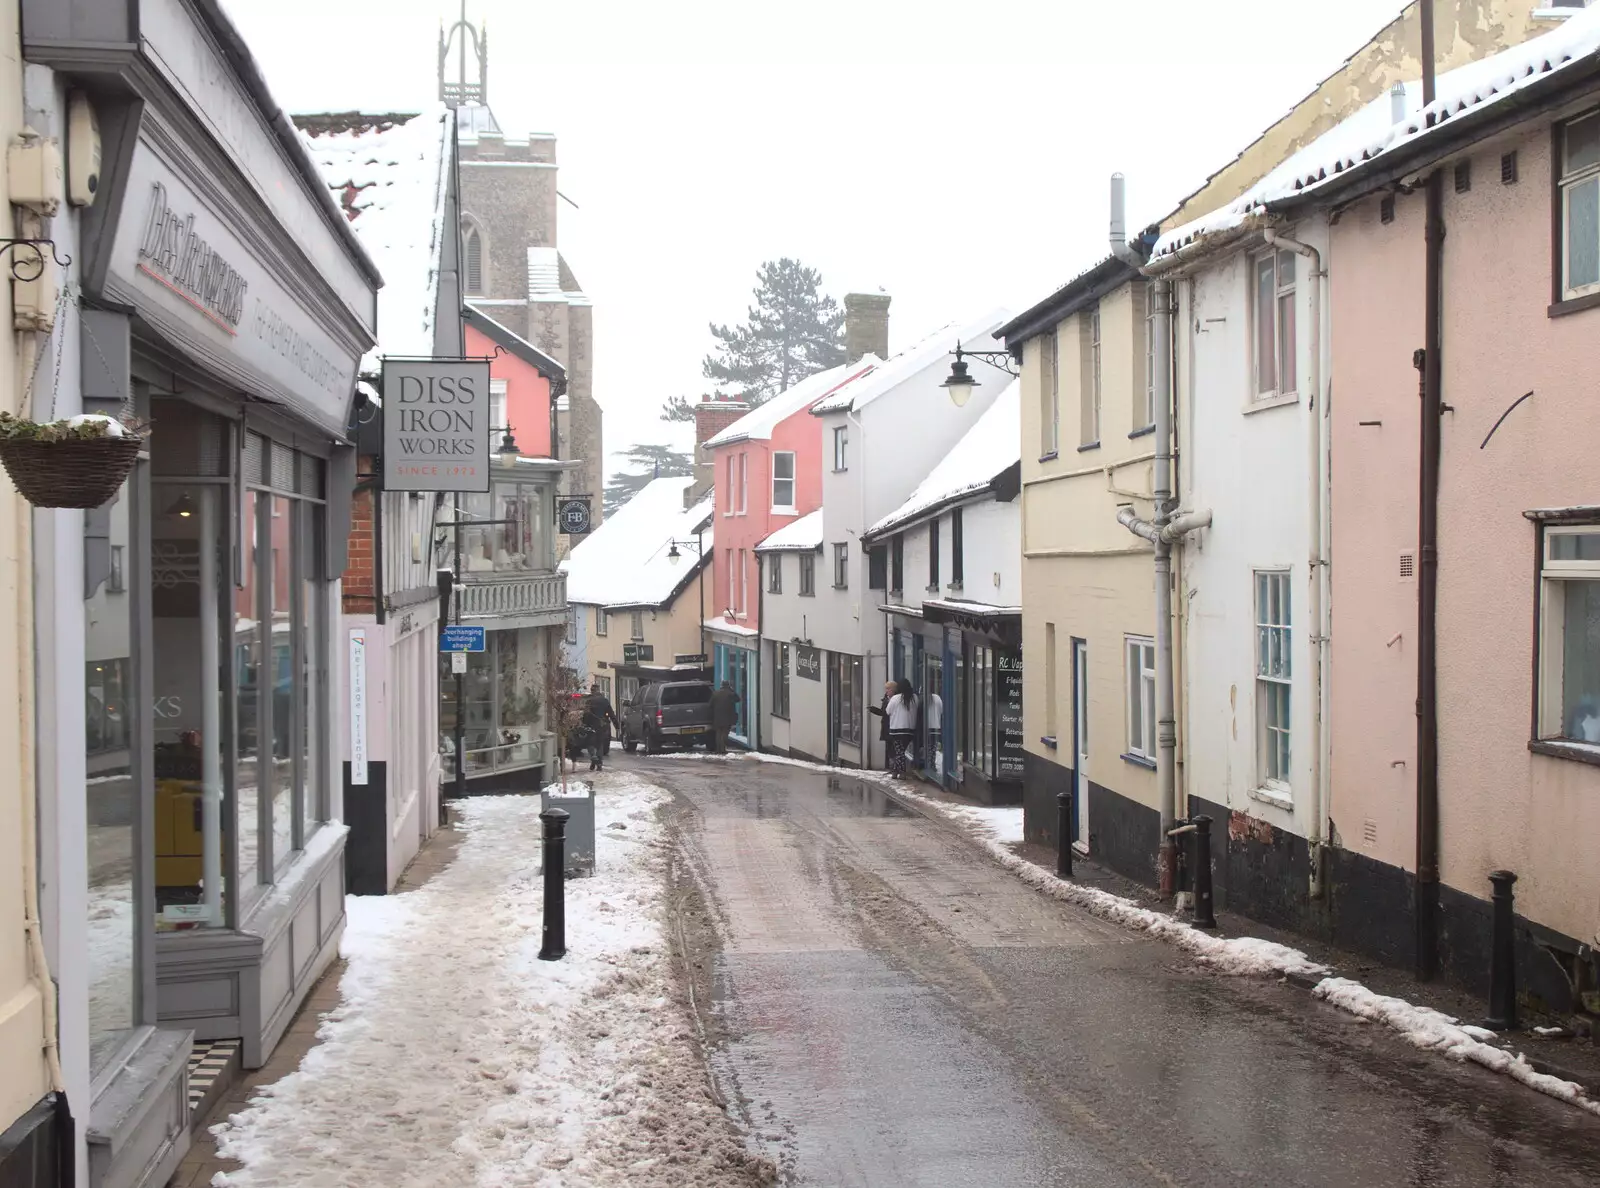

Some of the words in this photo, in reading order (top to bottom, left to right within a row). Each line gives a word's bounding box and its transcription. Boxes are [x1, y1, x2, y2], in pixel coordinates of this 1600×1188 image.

[398, 376, 476, 405] DISS
[398, 409, 475, 432] IRON
[399, 438, 476, 455] WORKS
[396, 466, 438, 476] SINCE
[998, 656, 1009, 669] RC
[354, 648, 362, 708] Heritage
